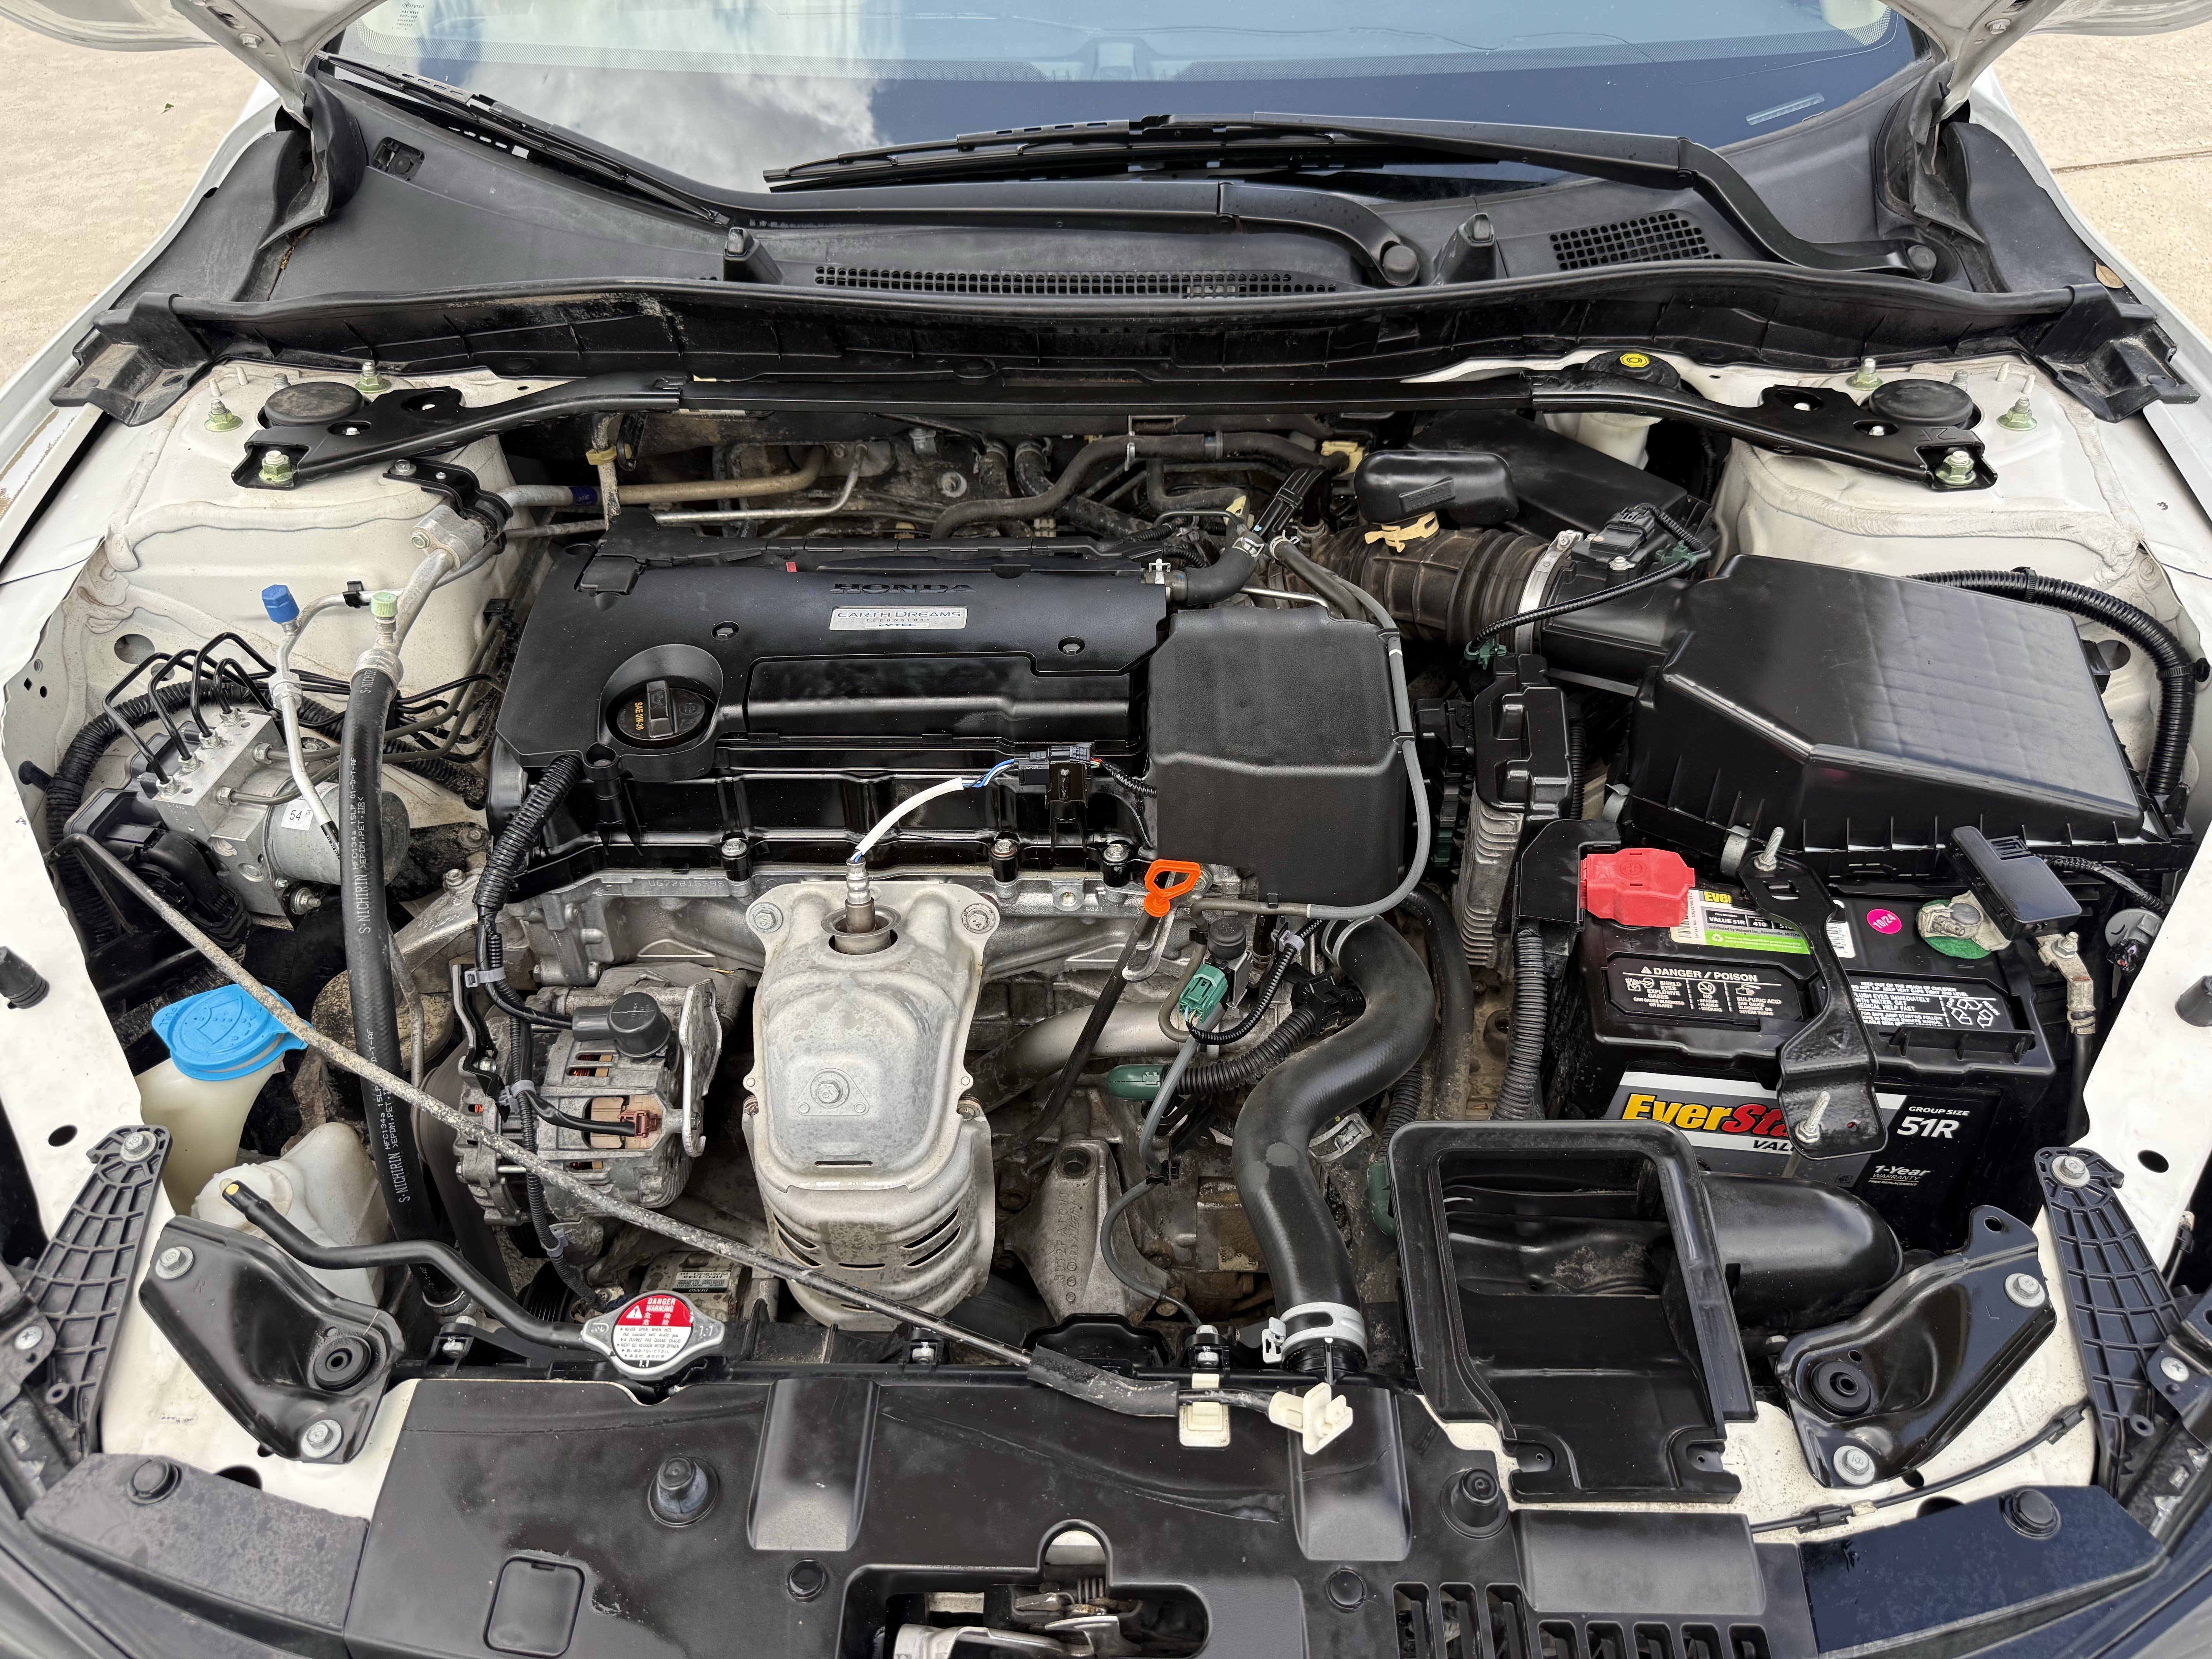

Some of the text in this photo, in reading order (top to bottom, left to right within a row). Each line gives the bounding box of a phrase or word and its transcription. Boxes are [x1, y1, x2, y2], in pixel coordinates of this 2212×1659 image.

[830, 584, 978, 594] HONDA
[634, 702, 644, 730] SAE 0W-20
[289, 809, 302, 821] 54
[1873, 913, 1896, 929] 10/24
[1653, 967, 1702, 978] DANGER
[1713, 972, 1758, 982] POISON
[1890, 995, 1930, 1003] IMMEDIATELY
[1622, 1093, 1788, 1137] EverSta
[1908, 1106, 1946, 1114] GROUP
[1897, 1116, 1960, 1139] 51R
[1753, 1140, 1794, 1152] VAL
[1874, 1165, 1931, 1176] 1-Year
[646, 1305, 674, 1313] WARNUNG
